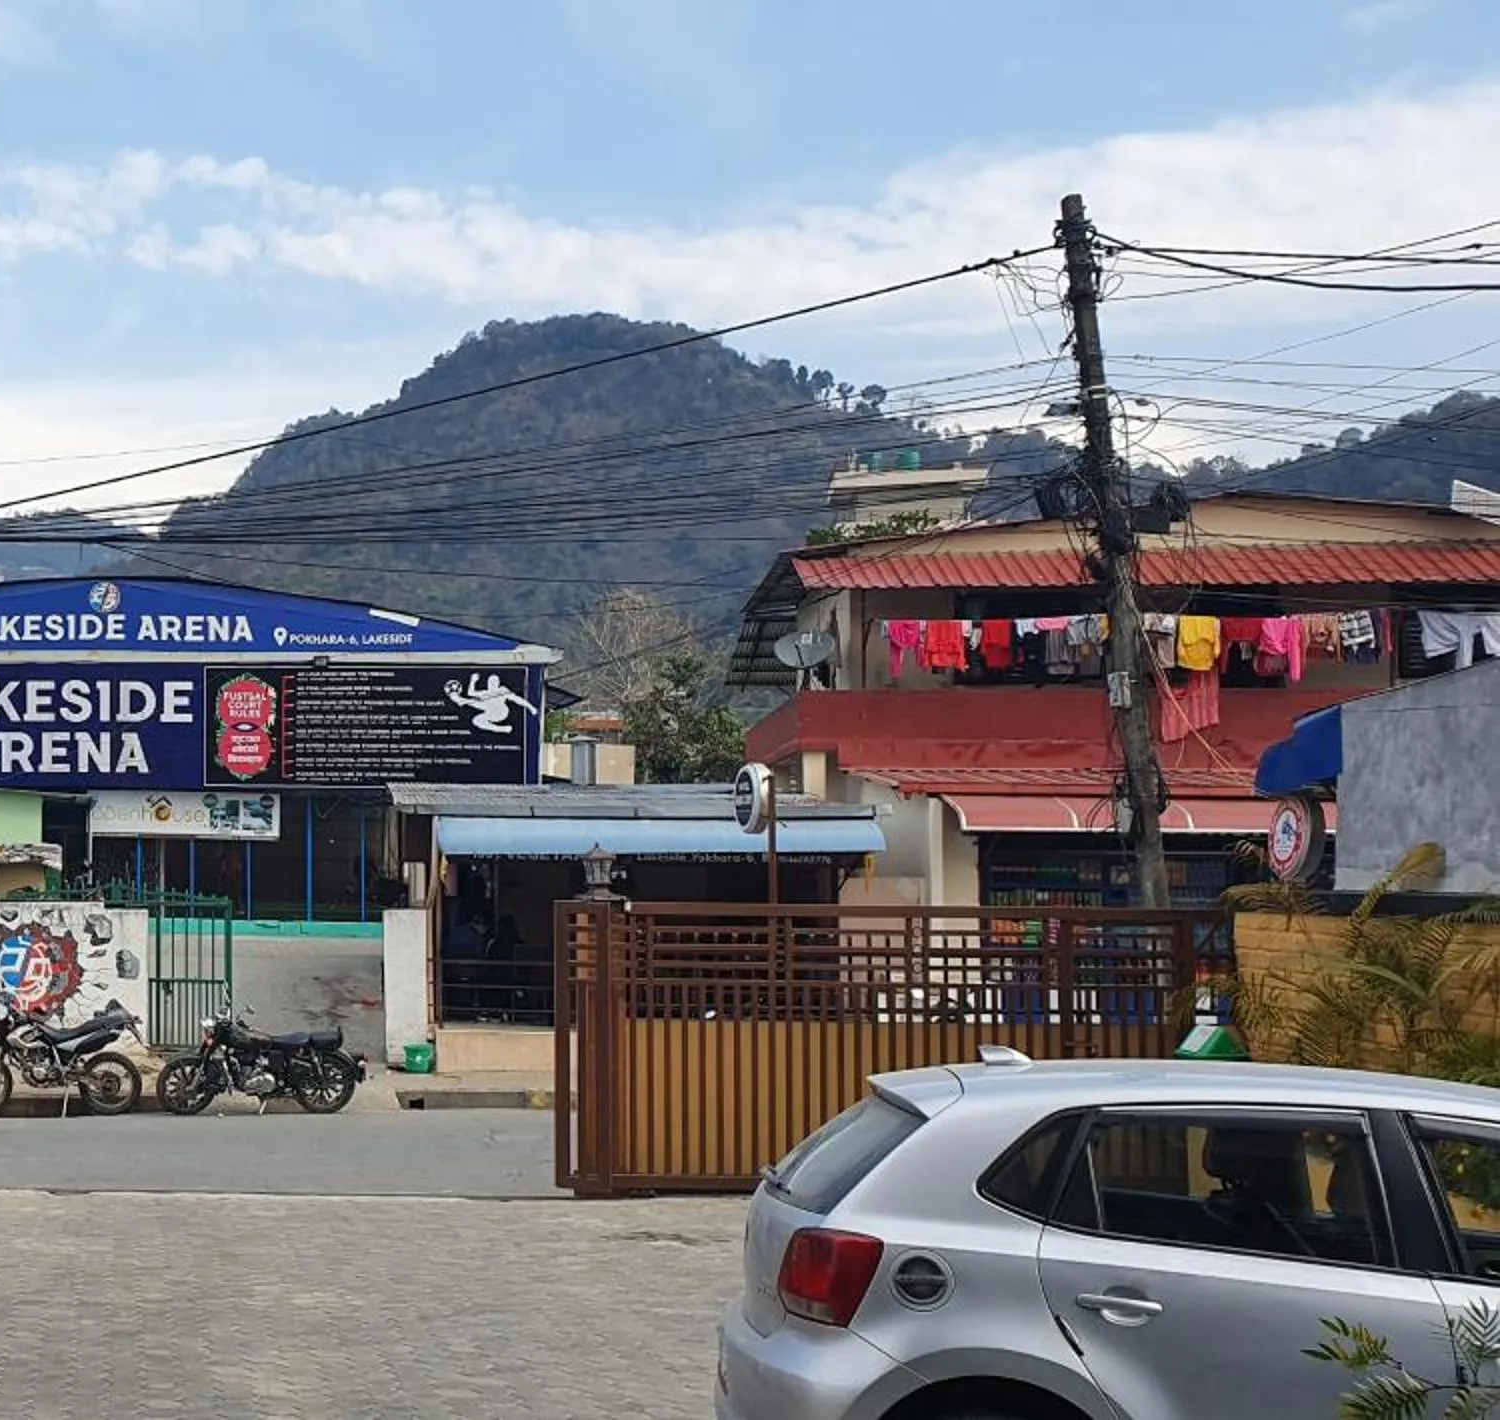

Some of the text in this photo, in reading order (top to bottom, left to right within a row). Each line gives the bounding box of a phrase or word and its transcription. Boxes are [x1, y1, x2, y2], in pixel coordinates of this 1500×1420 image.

[137, 615, 254, 641] ARENA
[362, 633, 413, 645] LAKESIDE
[228, 701, 261, 709] COURT
[229, 709, 261, 718] RULES
